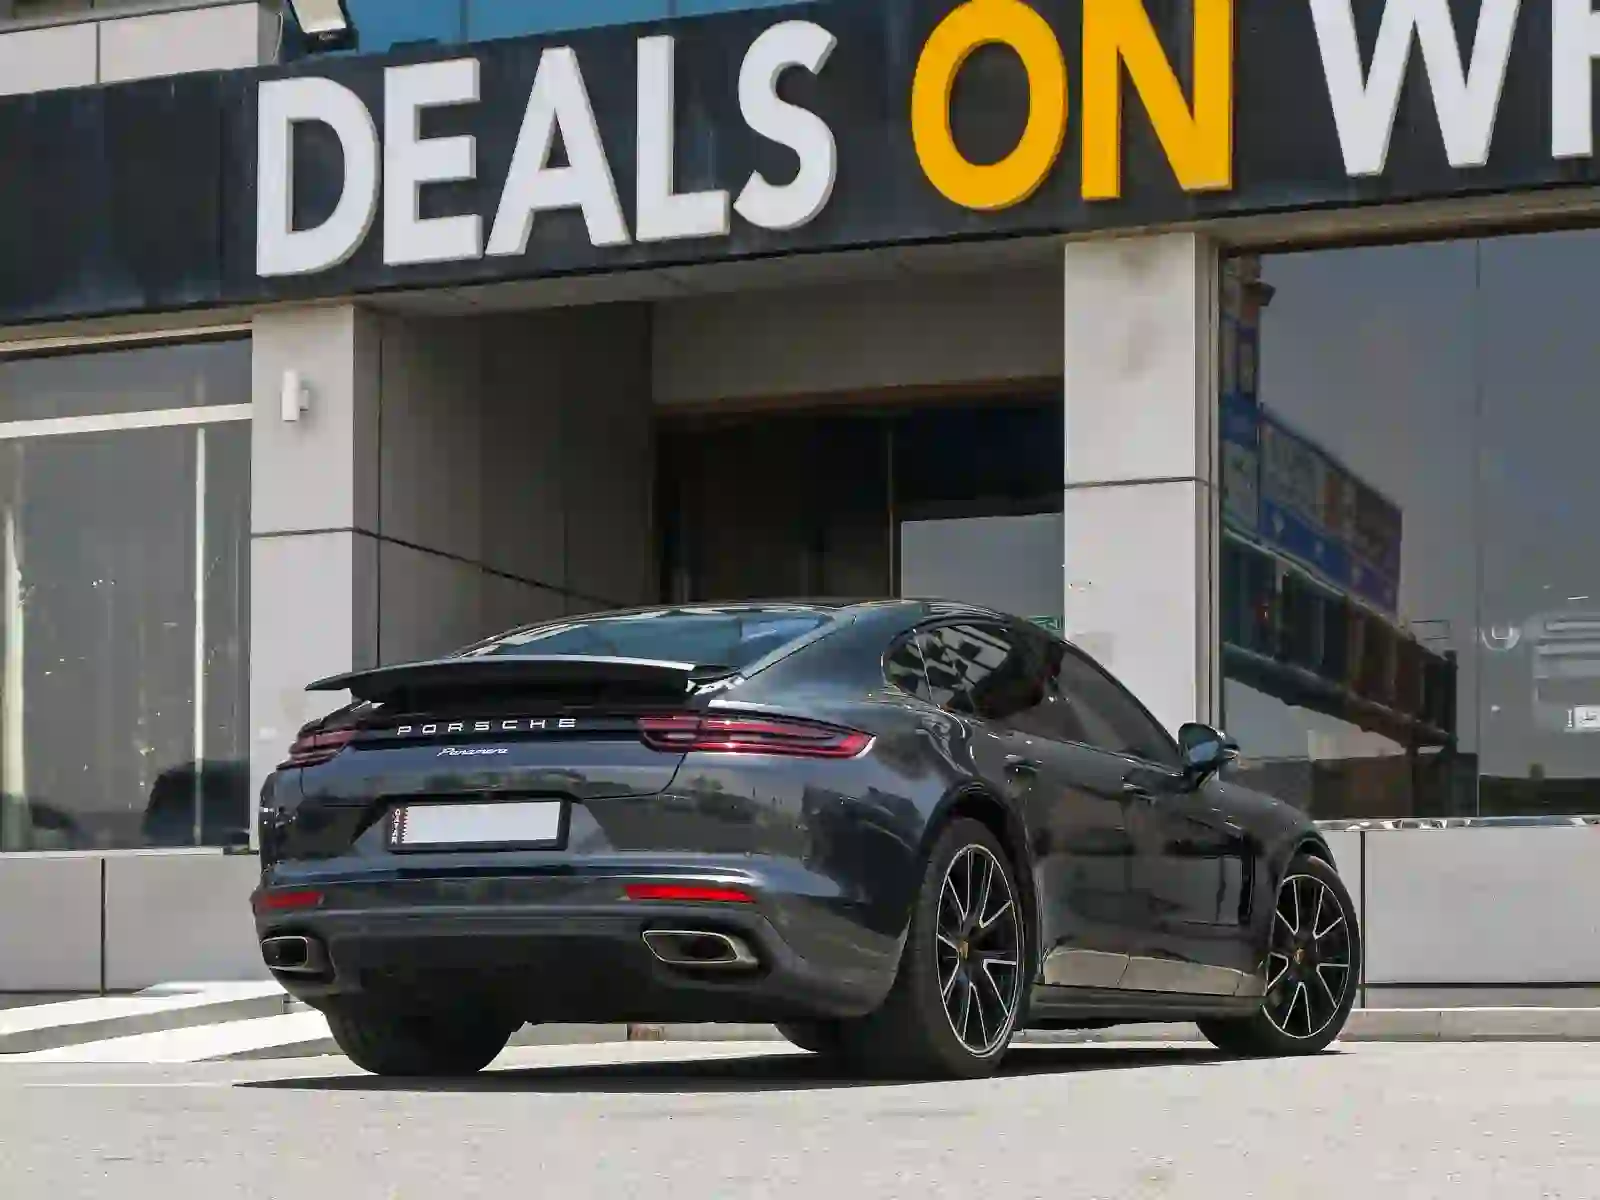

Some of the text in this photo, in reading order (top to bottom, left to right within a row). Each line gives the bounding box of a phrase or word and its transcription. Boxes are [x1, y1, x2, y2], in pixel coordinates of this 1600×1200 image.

[256, 20, 837, 277] DEALS
[911, 0, 1233, 209] ON
[397, 717, 577, 735] PORSCHE
[436, 747, 509, 757] Panamera
